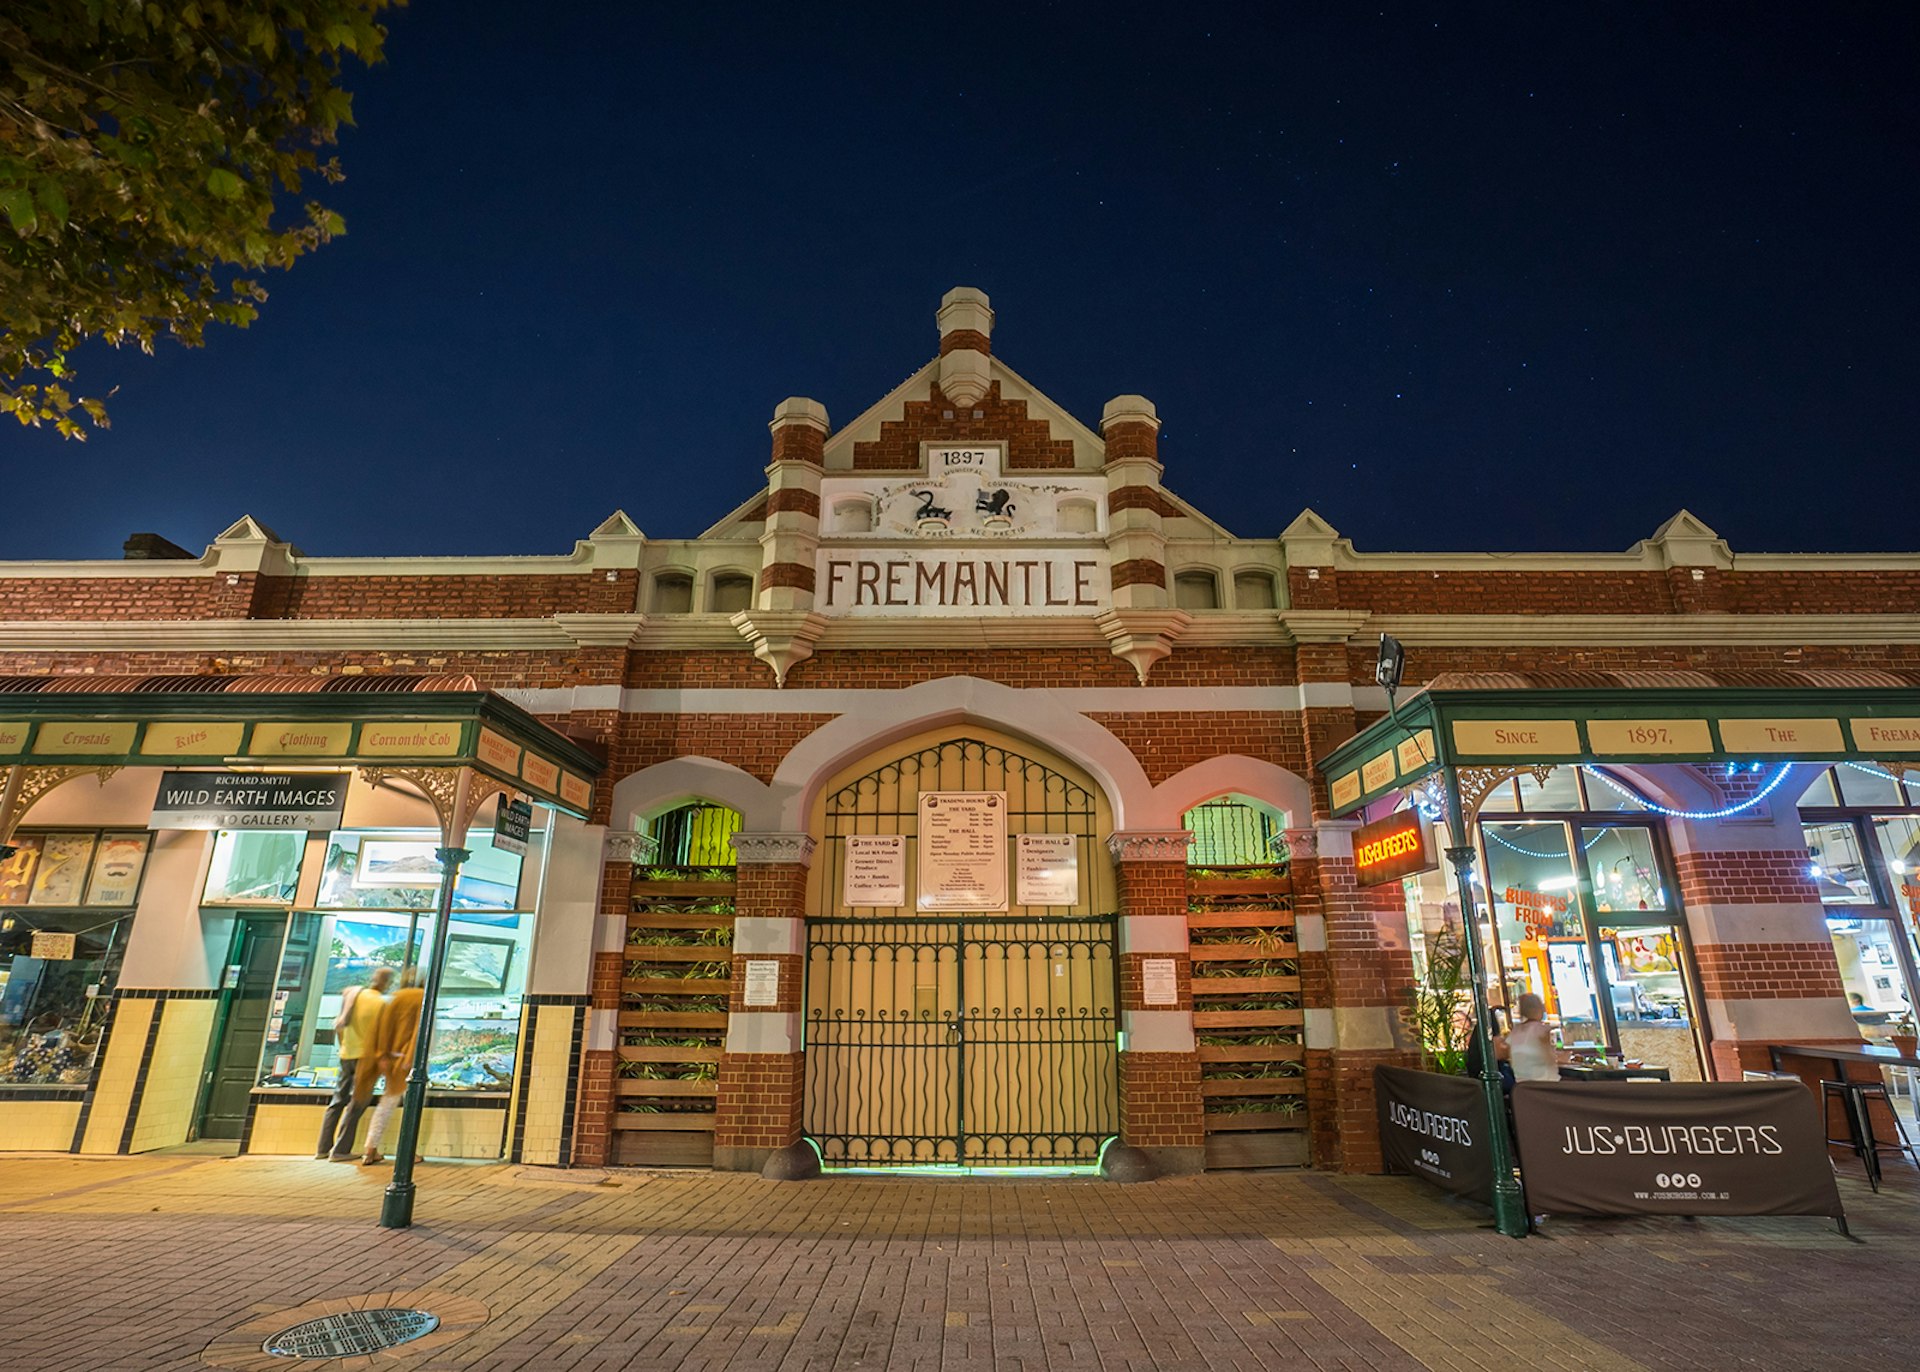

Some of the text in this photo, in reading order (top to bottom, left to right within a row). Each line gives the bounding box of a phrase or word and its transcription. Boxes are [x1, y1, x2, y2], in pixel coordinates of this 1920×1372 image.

[942, 452, 984, 466] 1897
[944, 468, 983, 476] MUNICIPAL
[904, 482, 943, 491] FREMANTLE
[987, 481, 1020, 490] COUNCIL
[904, 527, 920, 536] NEC
[970, 528, 986, 536] NEC
[825, 561, 1099, 606] FREMANTLE
[63, 732, 111, 745] Crystals
[175, 730, 208, 749] Kites
[279, 732, 328, 748] Clothing
[370, 732, 450, 747] Corn on the Cob
[1627, 727, 1673, 745] 1897,
[216, 776, 291, 784] RICHARD SMYTH
[166, 790, 336, 806] WILD EARTH IMAGES
[241, 814, 299, 826] GALLERY
[100, 890, 126, 901] TODAY
[1506, 887, 1567, 912] BURGERS
[1516, 906, 1553, 928] FROM
